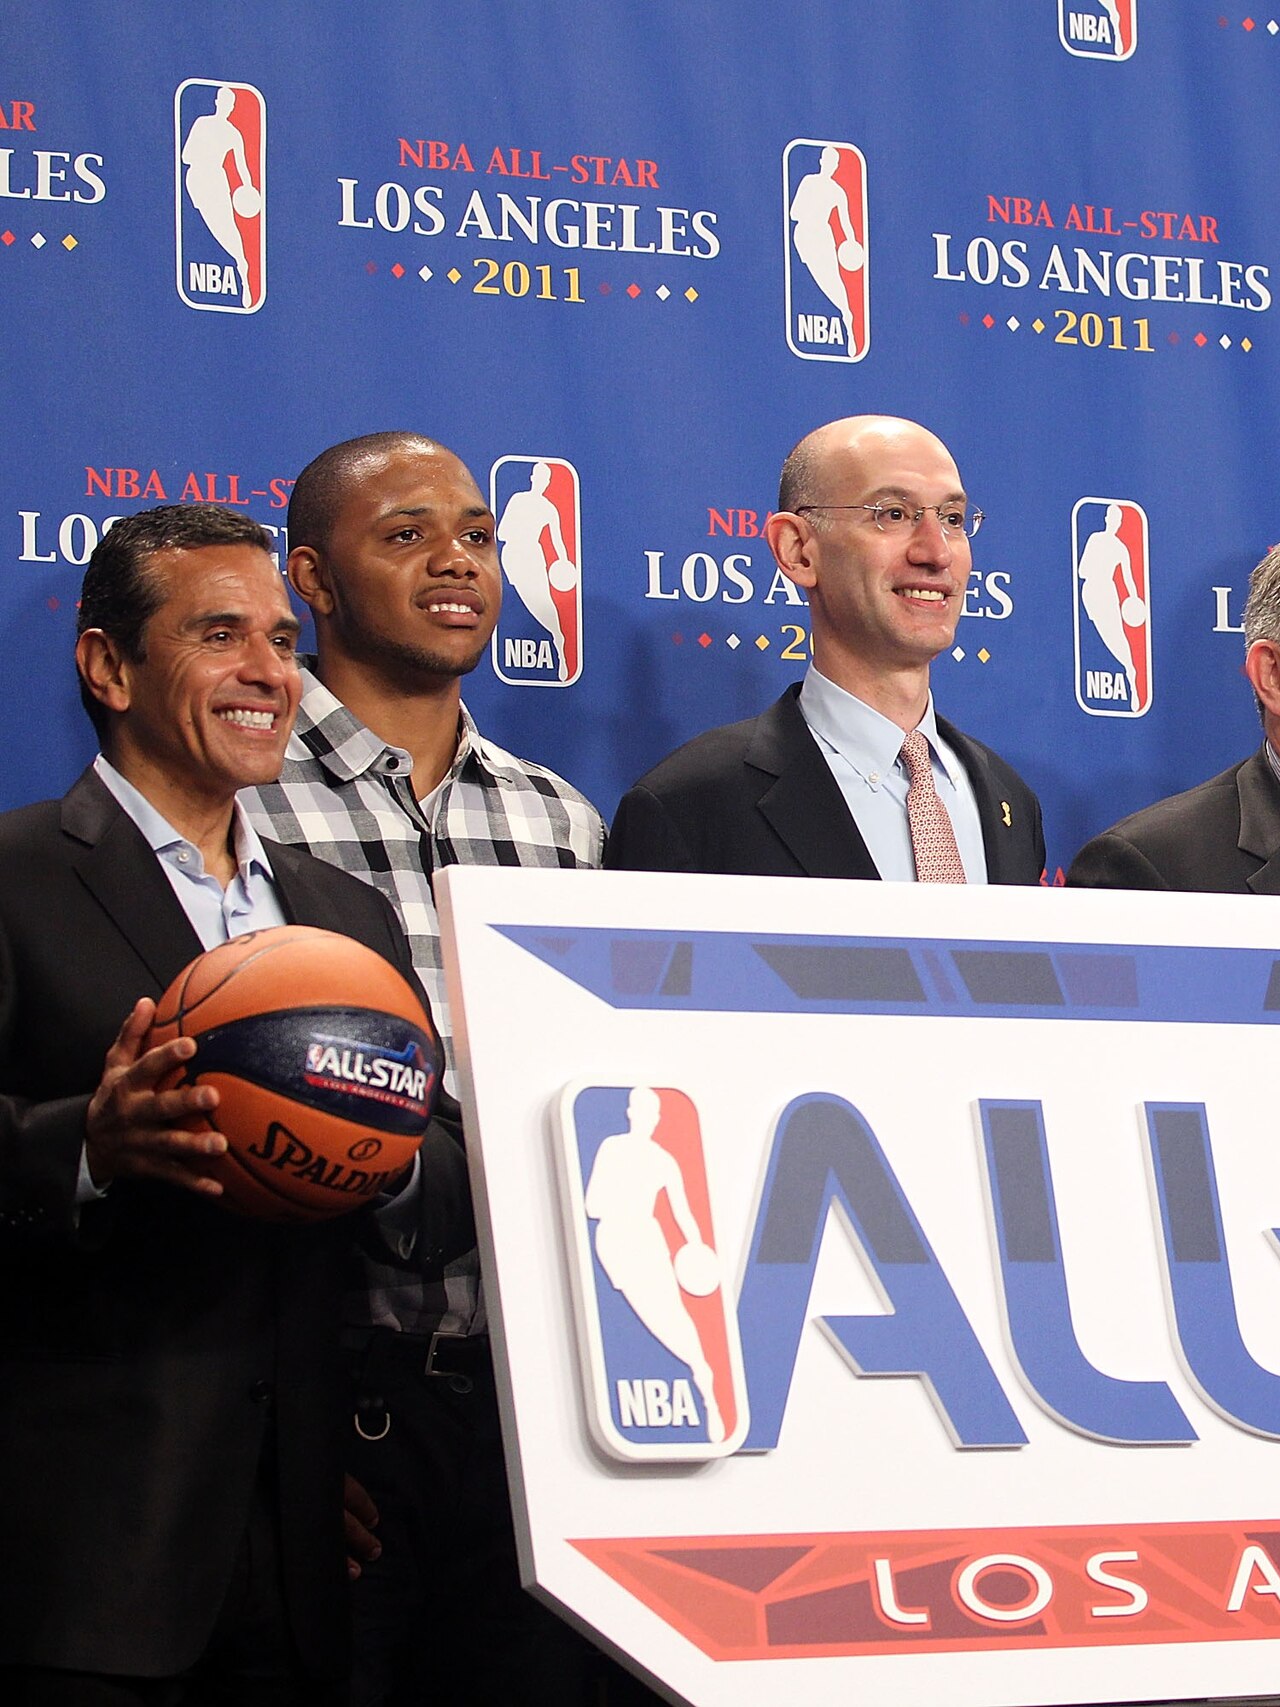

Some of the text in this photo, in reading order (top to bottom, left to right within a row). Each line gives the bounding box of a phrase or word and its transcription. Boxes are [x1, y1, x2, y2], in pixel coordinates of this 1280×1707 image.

[1070, 12, 1112, 44] NBA
[398, 138, 660, 189] NBA ALL-STAR
[337, 177, 721, 259] LOS ANGELES
[987, 195, 1220, 244] NBA ALL-STAR
[189, 262, 239, 296] NBA
[472, 259, 586, 303] 2011
[932, 233, 1272, 312] LOS ANGELES
[798, 313, 844, 346] NBA
[1053, 310, 1155, 352] 2011
[85, 466, 296, 509] NBA ALL-S
[643, 550, 754, 604] LOS
[504, 637, 555, 670] NBA
[1086, 670, 1129, 702] NBA
[315, 1046, 427, 1101] ALL-STAR
[616, 1378, 701, 1428] NBA
[874, 1550, 1149, 1625] LOS
